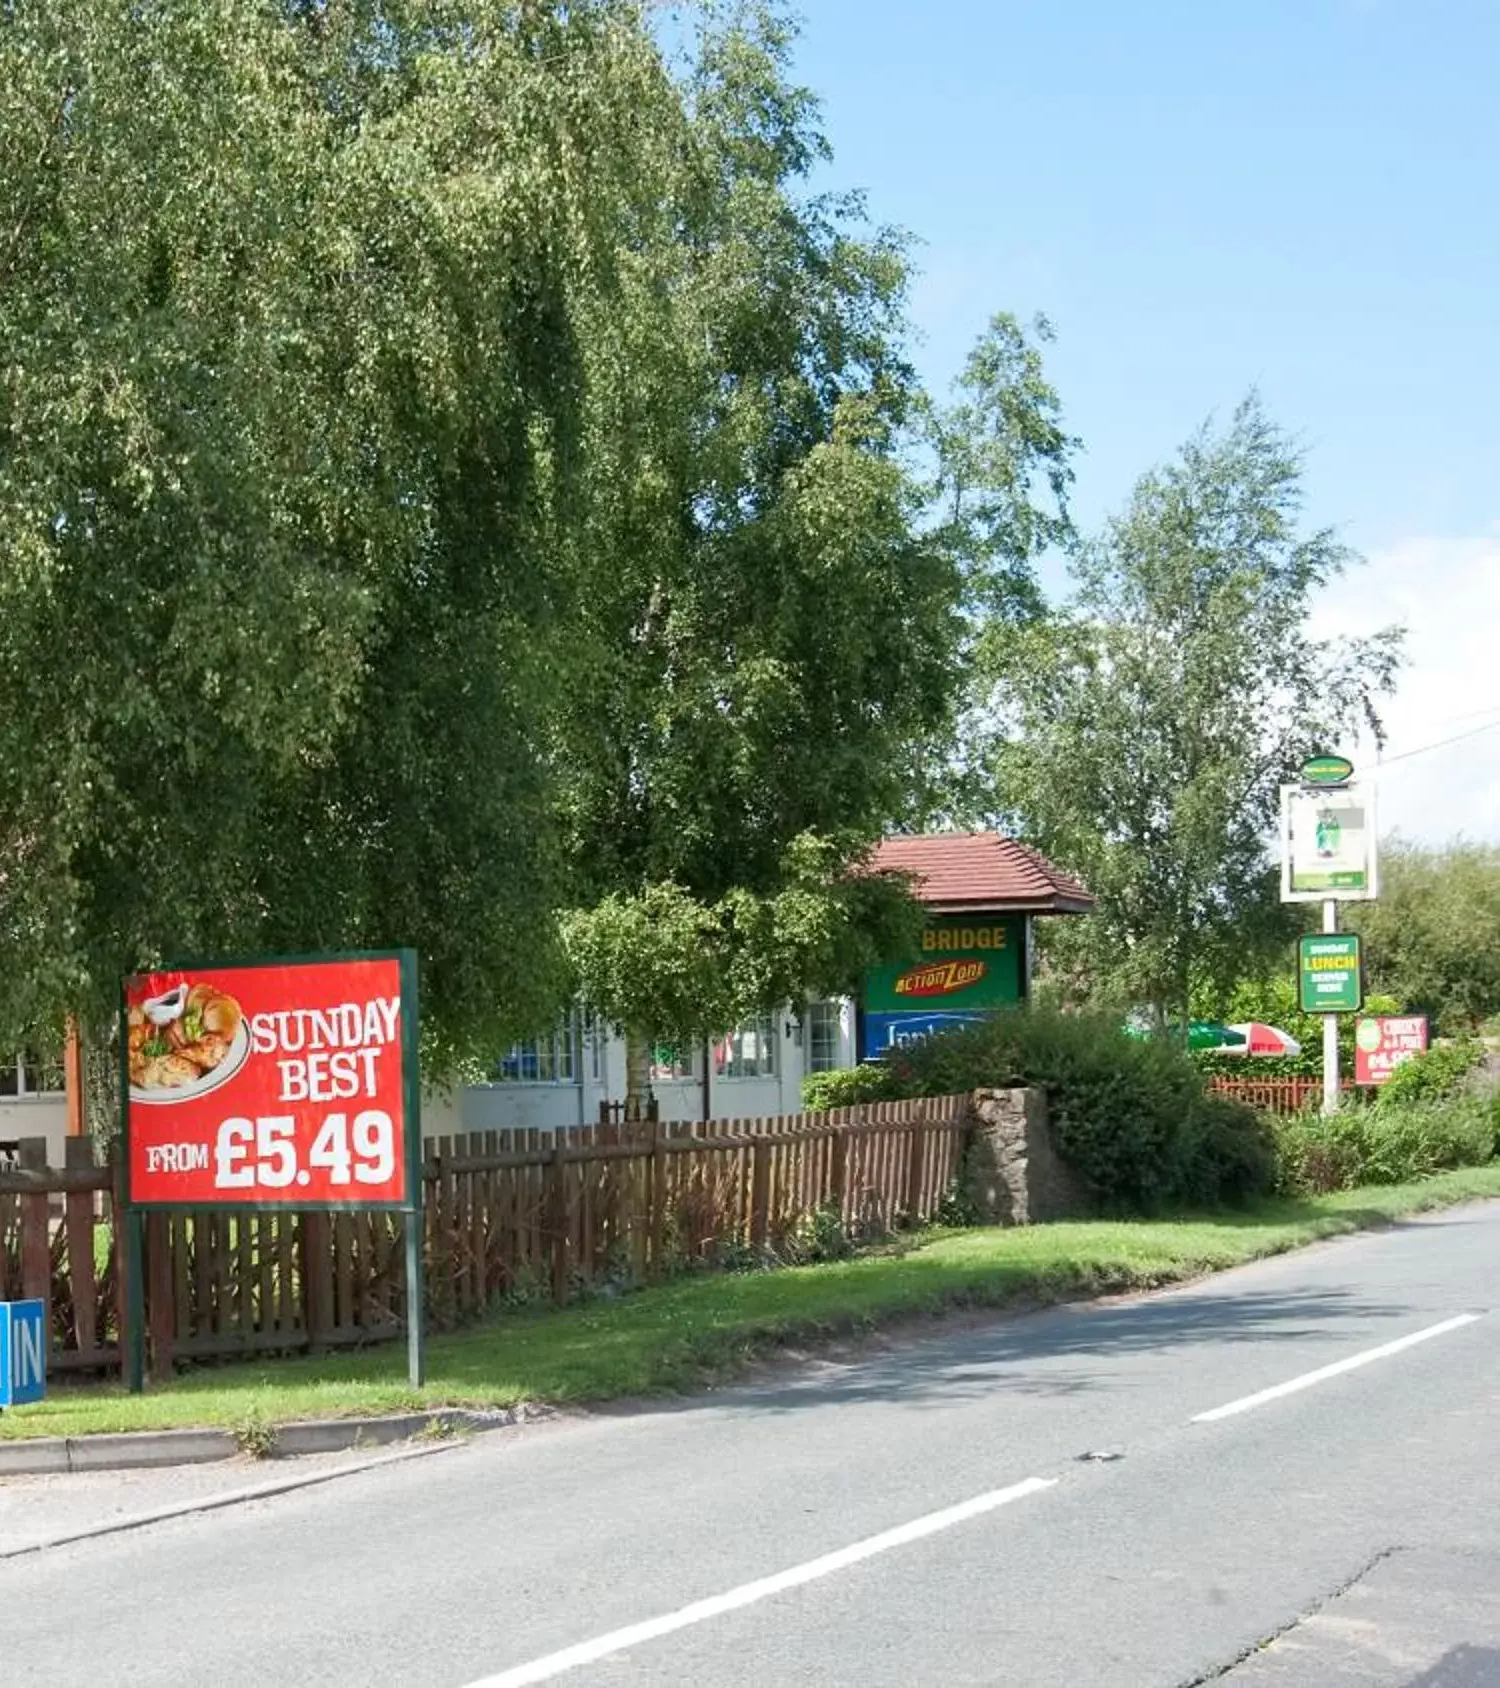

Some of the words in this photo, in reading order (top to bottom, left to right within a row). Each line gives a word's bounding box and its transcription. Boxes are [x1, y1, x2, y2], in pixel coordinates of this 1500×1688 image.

[922, 927, 1007, 951] BRIDGE
[1304, 955, 1355, 970] LUNCH
[251, 997, 401, 1053] SUNDAY
[277, 1048, 381, 1102] BEST
[145, 1142, 209, 1173] FROM
[214, 1110, 396, 1188] £5.49
[14, 1317, 41, 1388] IN
